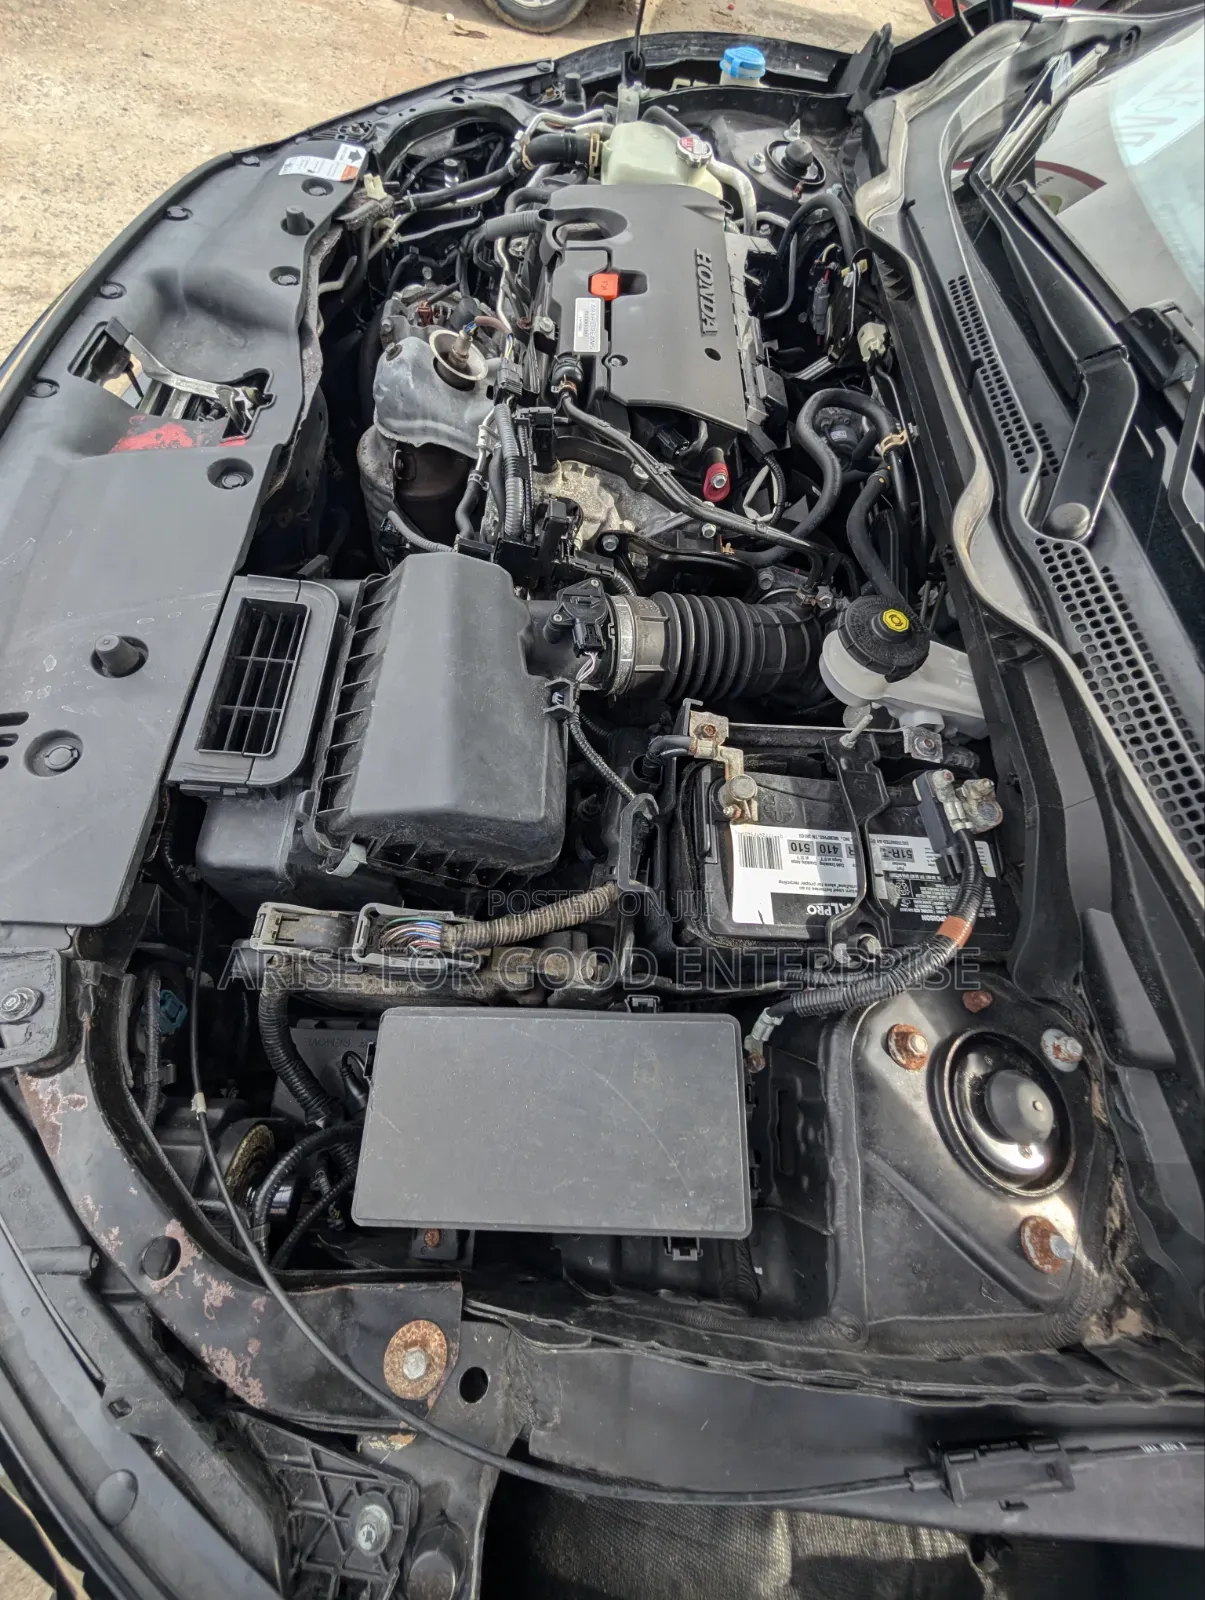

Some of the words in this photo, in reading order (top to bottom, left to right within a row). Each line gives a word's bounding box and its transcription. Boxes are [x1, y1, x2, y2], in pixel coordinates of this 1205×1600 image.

[694, 247, 718, 337] HONDA
[790, 842, 810, 853] 510
[819, 843, 839, 855] 410
